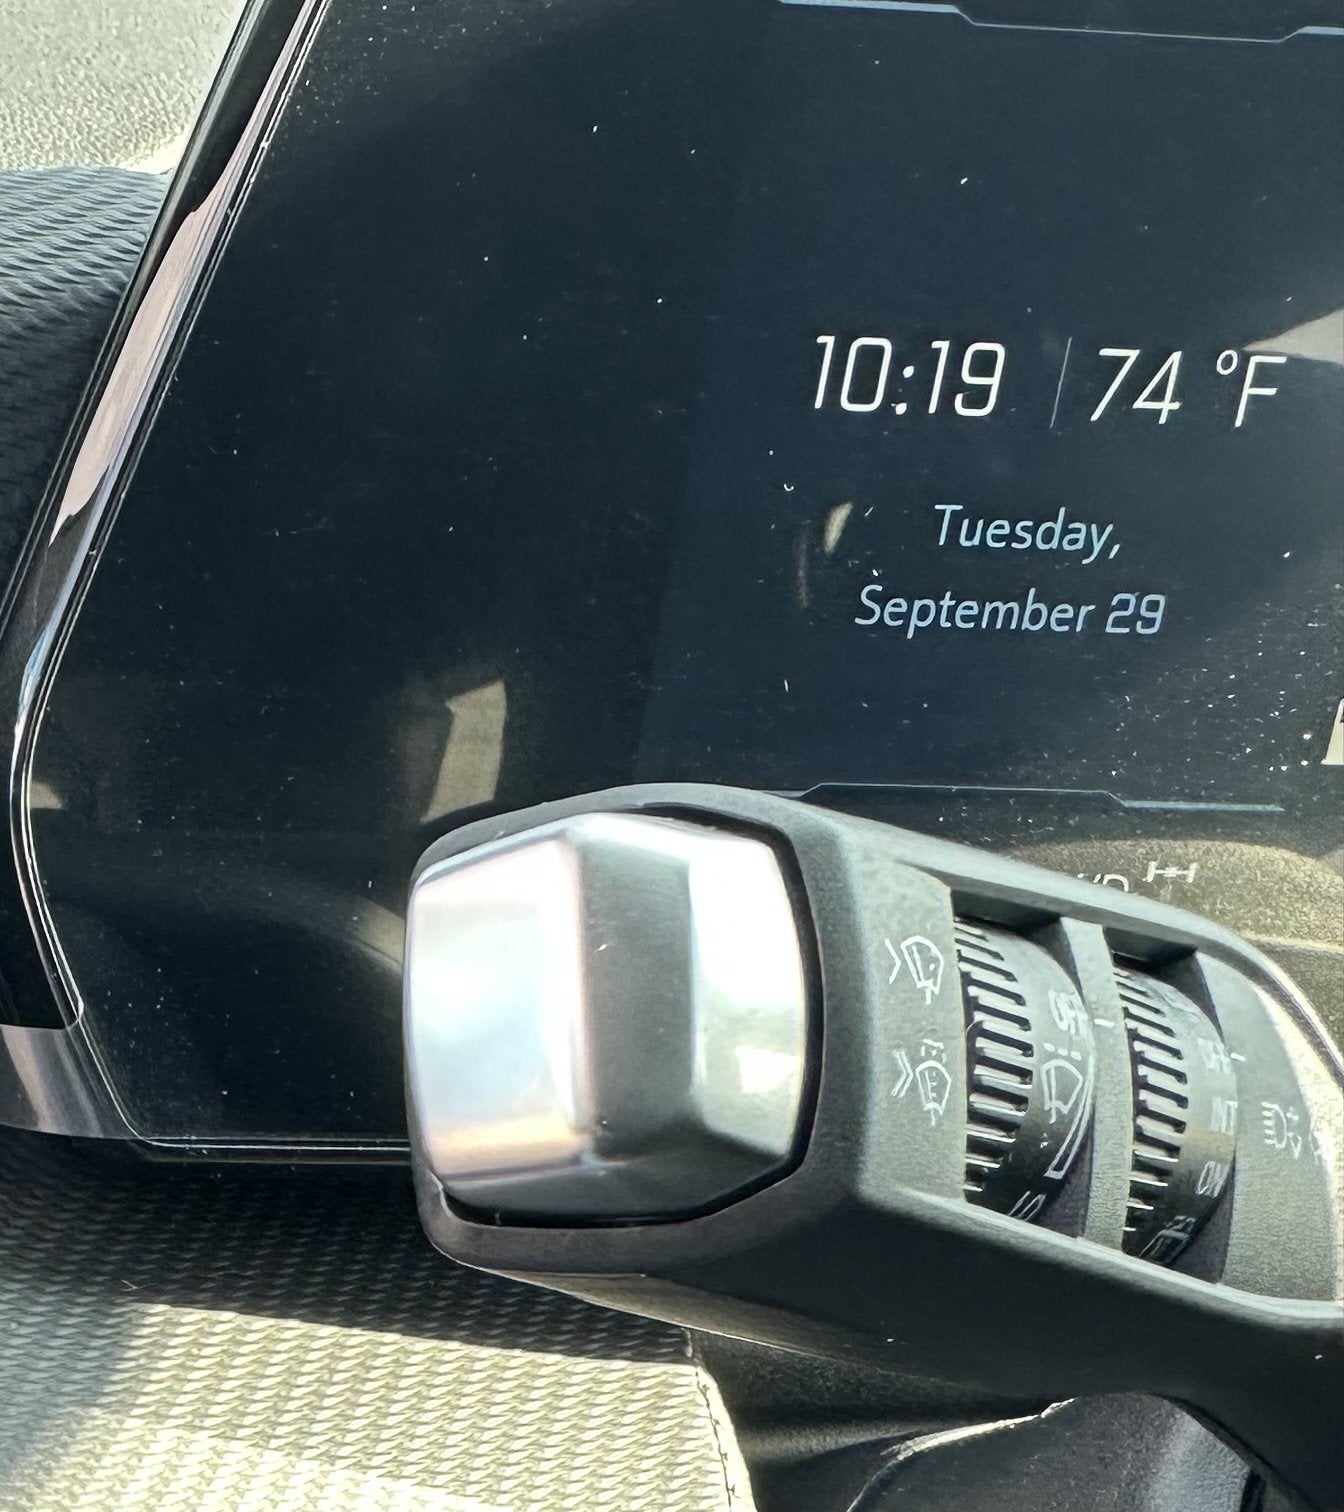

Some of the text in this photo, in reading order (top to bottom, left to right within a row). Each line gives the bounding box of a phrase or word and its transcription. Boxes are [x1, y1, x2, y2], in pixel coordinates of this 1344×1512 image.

[815, 336, 1005, 416] 10:19
[1091, 348, 1182, 424] 74
[935, 505, 1120, 564] Tuesday,
[855, 585, 1165, 639] September 29
